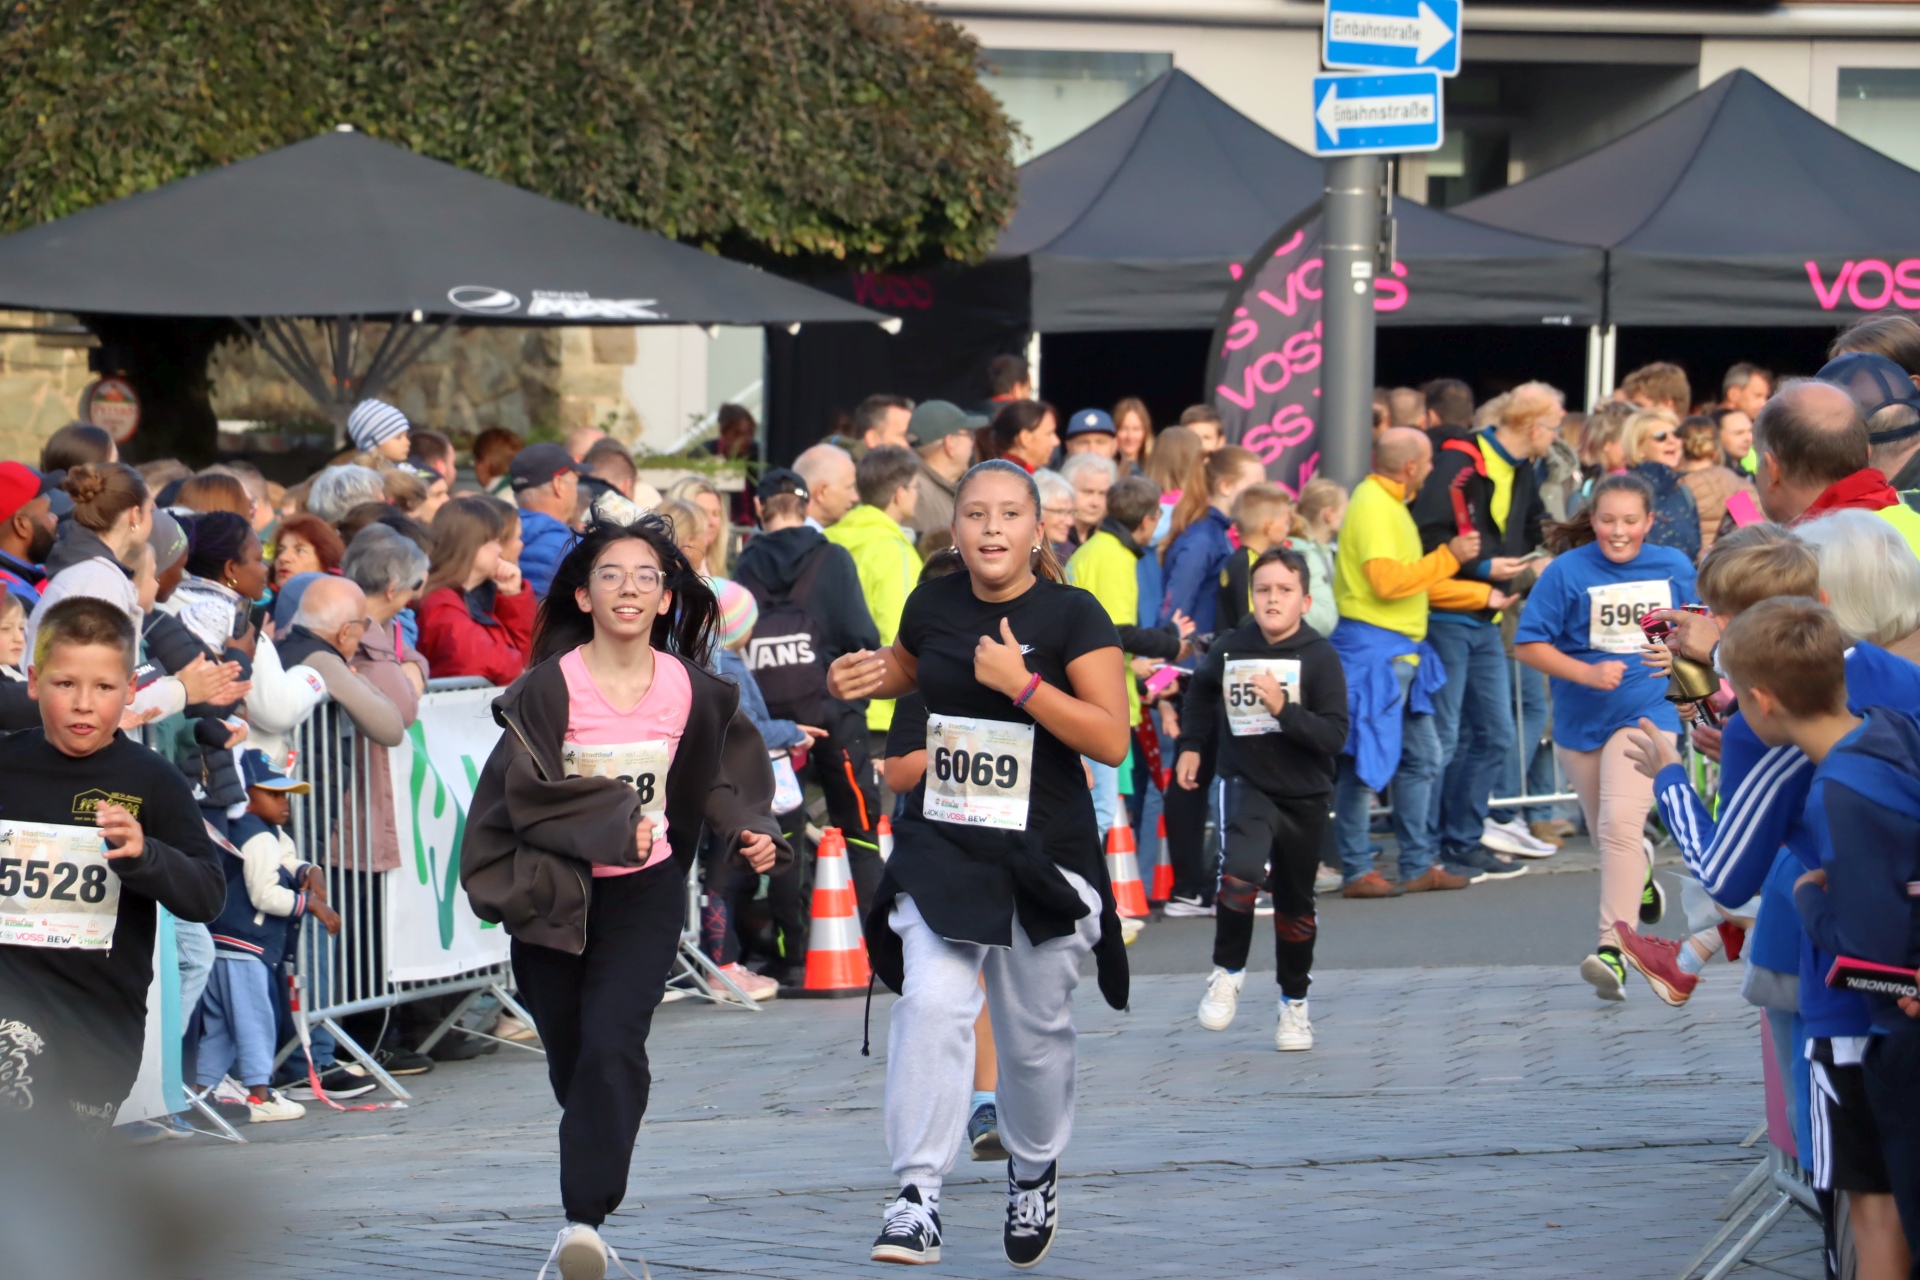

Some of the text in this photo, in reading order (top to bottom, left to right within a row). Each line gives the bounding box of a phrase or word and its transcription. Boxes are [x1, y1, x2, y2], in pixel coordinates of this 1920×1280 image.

[1333, 18, 1421, 41] Einbahnstraße
[740, 632, 816, 671] VANS
[1230, 681, 1290, 707] 555
[935, 746, 1019, 788] 6069
[946, 812, 966, 821] VOSS
[968, 815, 987, 823] BEW
[21, 829, 58, 838] Stadtlauf
[0, 857, 108, 904] 5528
[15, 931, 45, 942] VOSS
[47, 935, 72, 944] BEW
[1846, 976, 1918, 998] CHANCEN.
